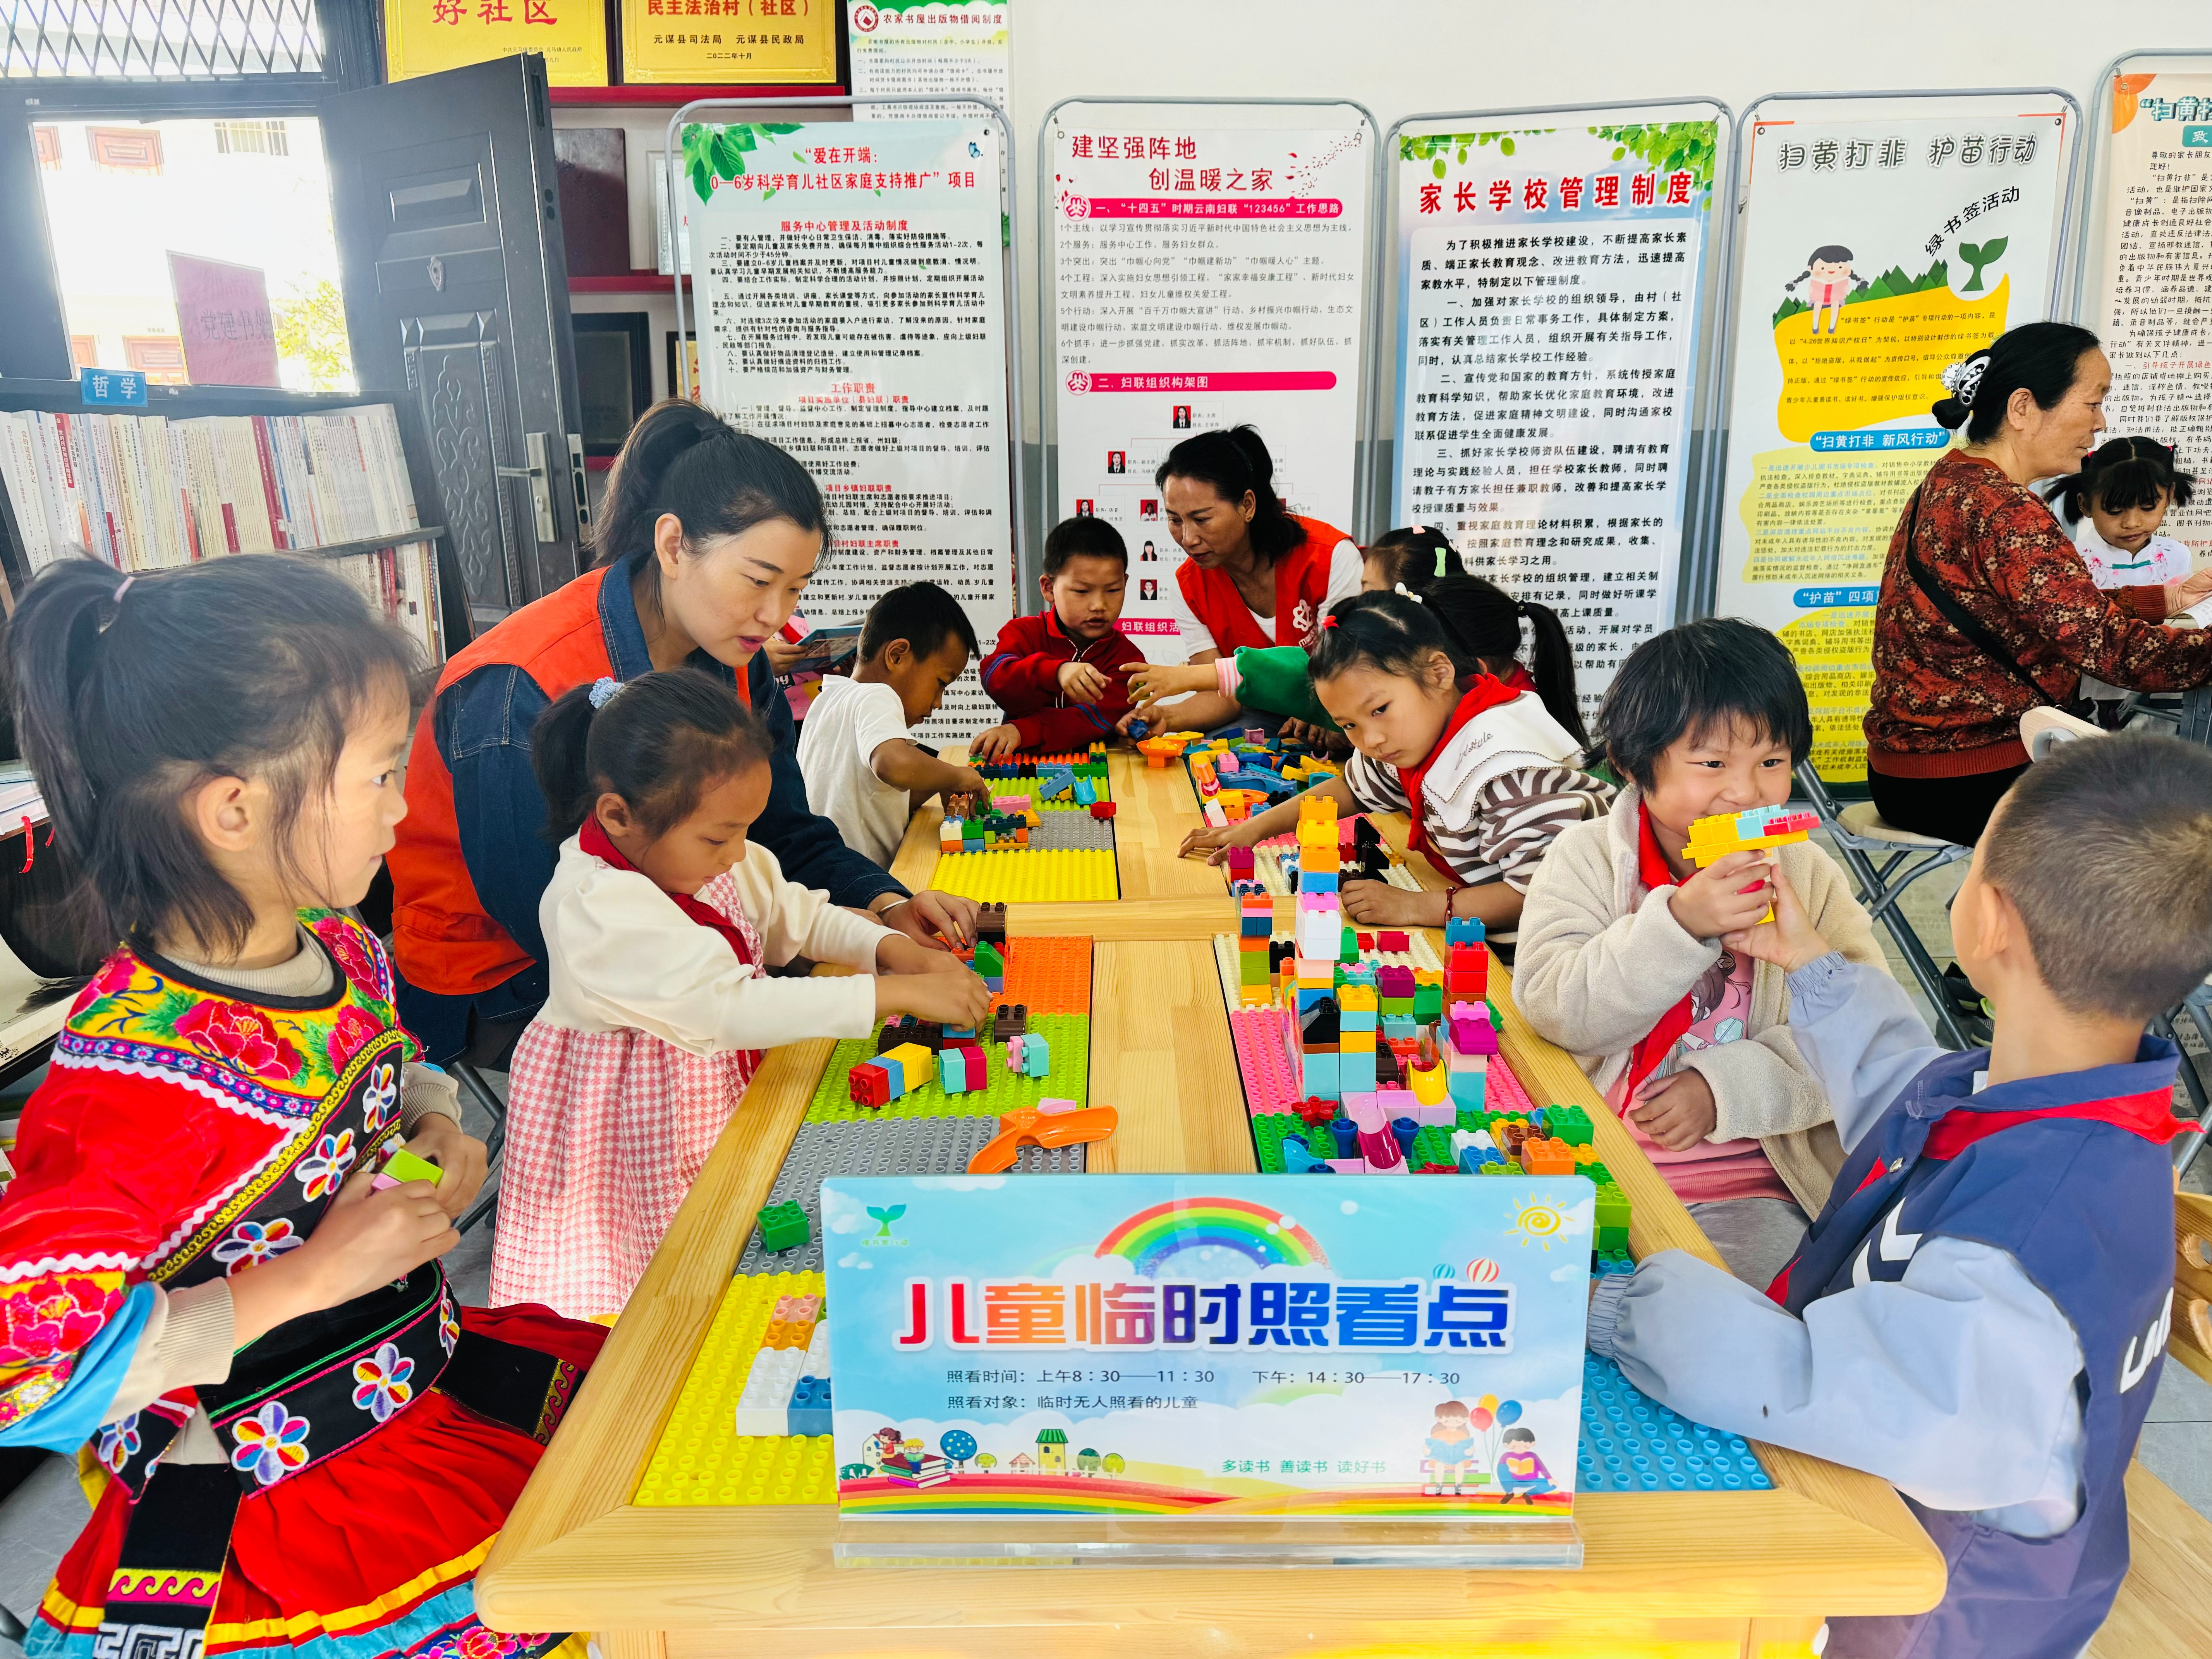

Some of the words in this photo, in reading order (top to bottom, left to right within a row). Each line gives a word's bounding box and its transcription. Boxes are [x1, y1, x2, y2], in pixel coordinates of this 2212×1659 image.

[433, 0, 558, 25] 好社区
[883, 14, 1002, 24] 农家书屋出版物借阅制度
[654, 34, 722, 45] 元谋县司法局
[736, 34, 804, 45] 元谋县民政局
[2192, 130, 2209, 143] 致
[1072, 134, 1197, 160] 建坚强阵地
[1779, 139, 1907, 172] 扫黄打非
[1928, 134, 2037, 167] 护苗行动
[1149, 168, 1273, 192] 创温暖之家
[1419, 171, 1694, 215] 家长学校管理制度
[781, 220, 908, 232] 服务中心管理及活动制度
[1925, 186, 2020, 256] 绿书签活动
[2122, 230, 2212, 239] 活动，查处违反法律法
[92, 374, 137, 399] 哲学
[831, 383, 875, 393] 工作职责
[1098, 375, 1209, 389] 二、妇联组织构架图
[825, 484, 892, 492] 项目乡镇妇联职责
[1803, 590, 1877, 604] “护苗”四项
[898, 1281, 1509, 1349] 儿童临时照看点
[1222, 1459, 1271, 1474] 多读书
[1280, 1459, 1328, 1474] 善读书
[1337, 1459, 1386, 1474] 读好书
